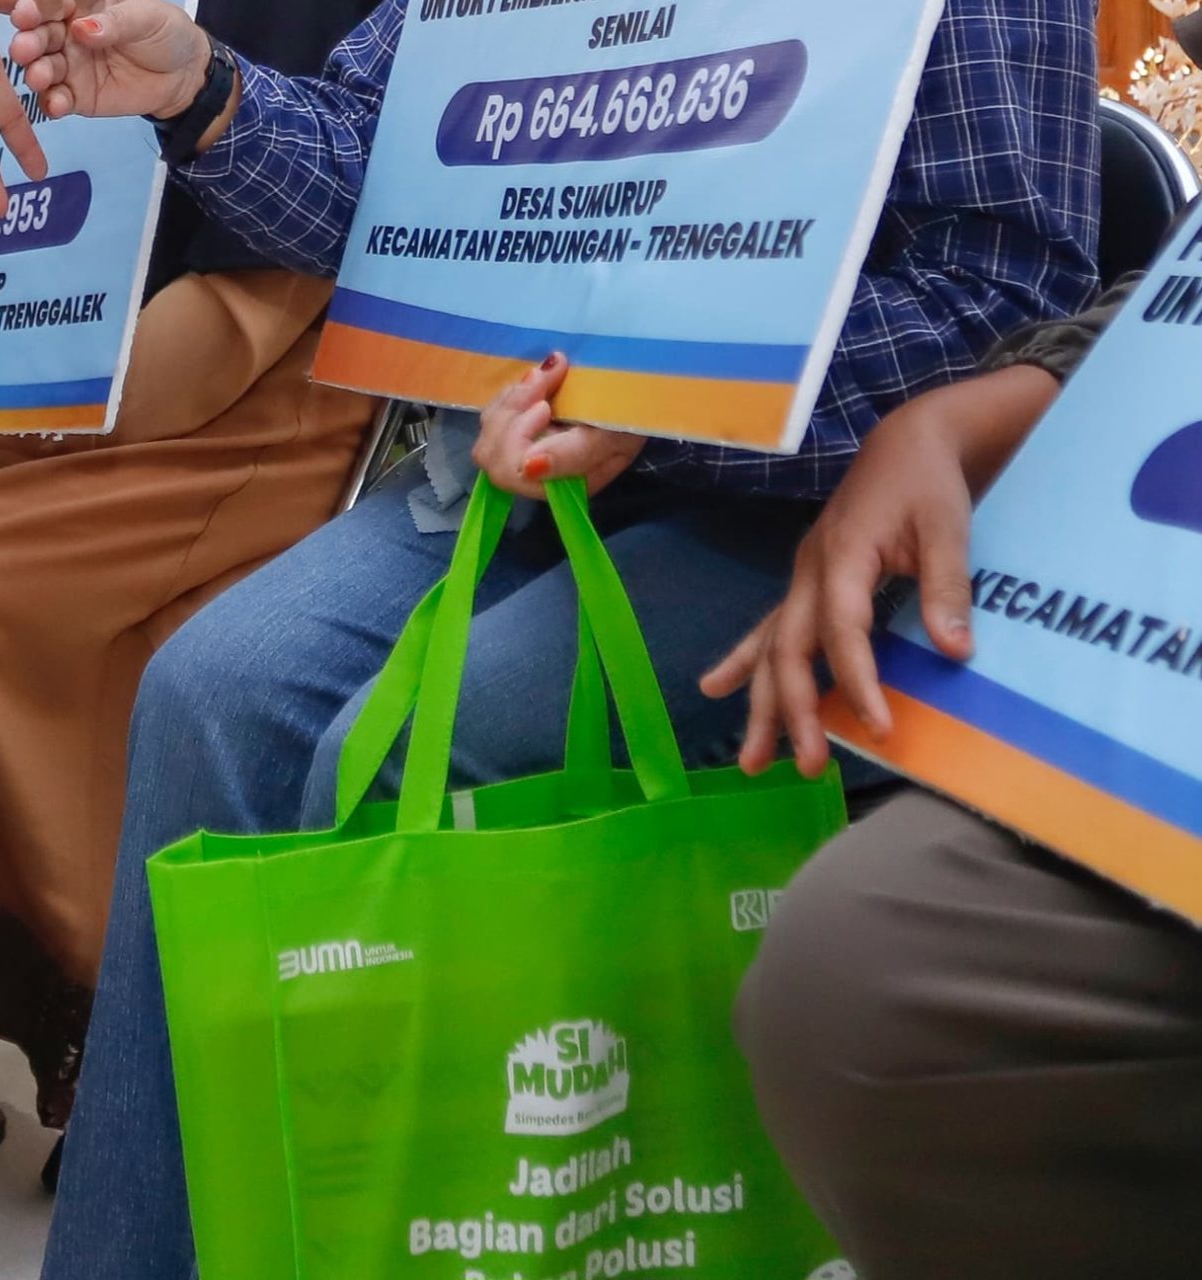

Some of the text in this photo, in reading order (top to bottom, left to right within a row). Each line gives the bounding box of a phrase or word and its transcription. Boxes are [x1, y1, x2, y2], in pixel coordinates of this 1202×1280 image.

[587, 4, 677, 50] SENILAI
[475, 94, 524, 160] Rp
[499, 179, 668, 221] DESA SUMURUP
[365, 224, 499, 262] KECAMATAN
[494, 227, 634, 265] BENDUNGAN
[644, 219, 816, 262] TRENGGALEK
[512, 1038, 627, 1101] MUDAH
[554, 1026, 591, 1065] SI
[509, 1136, 631, 1197] Jadilah
[409, 1172, 744, 1259] Bagian dari Solusi
